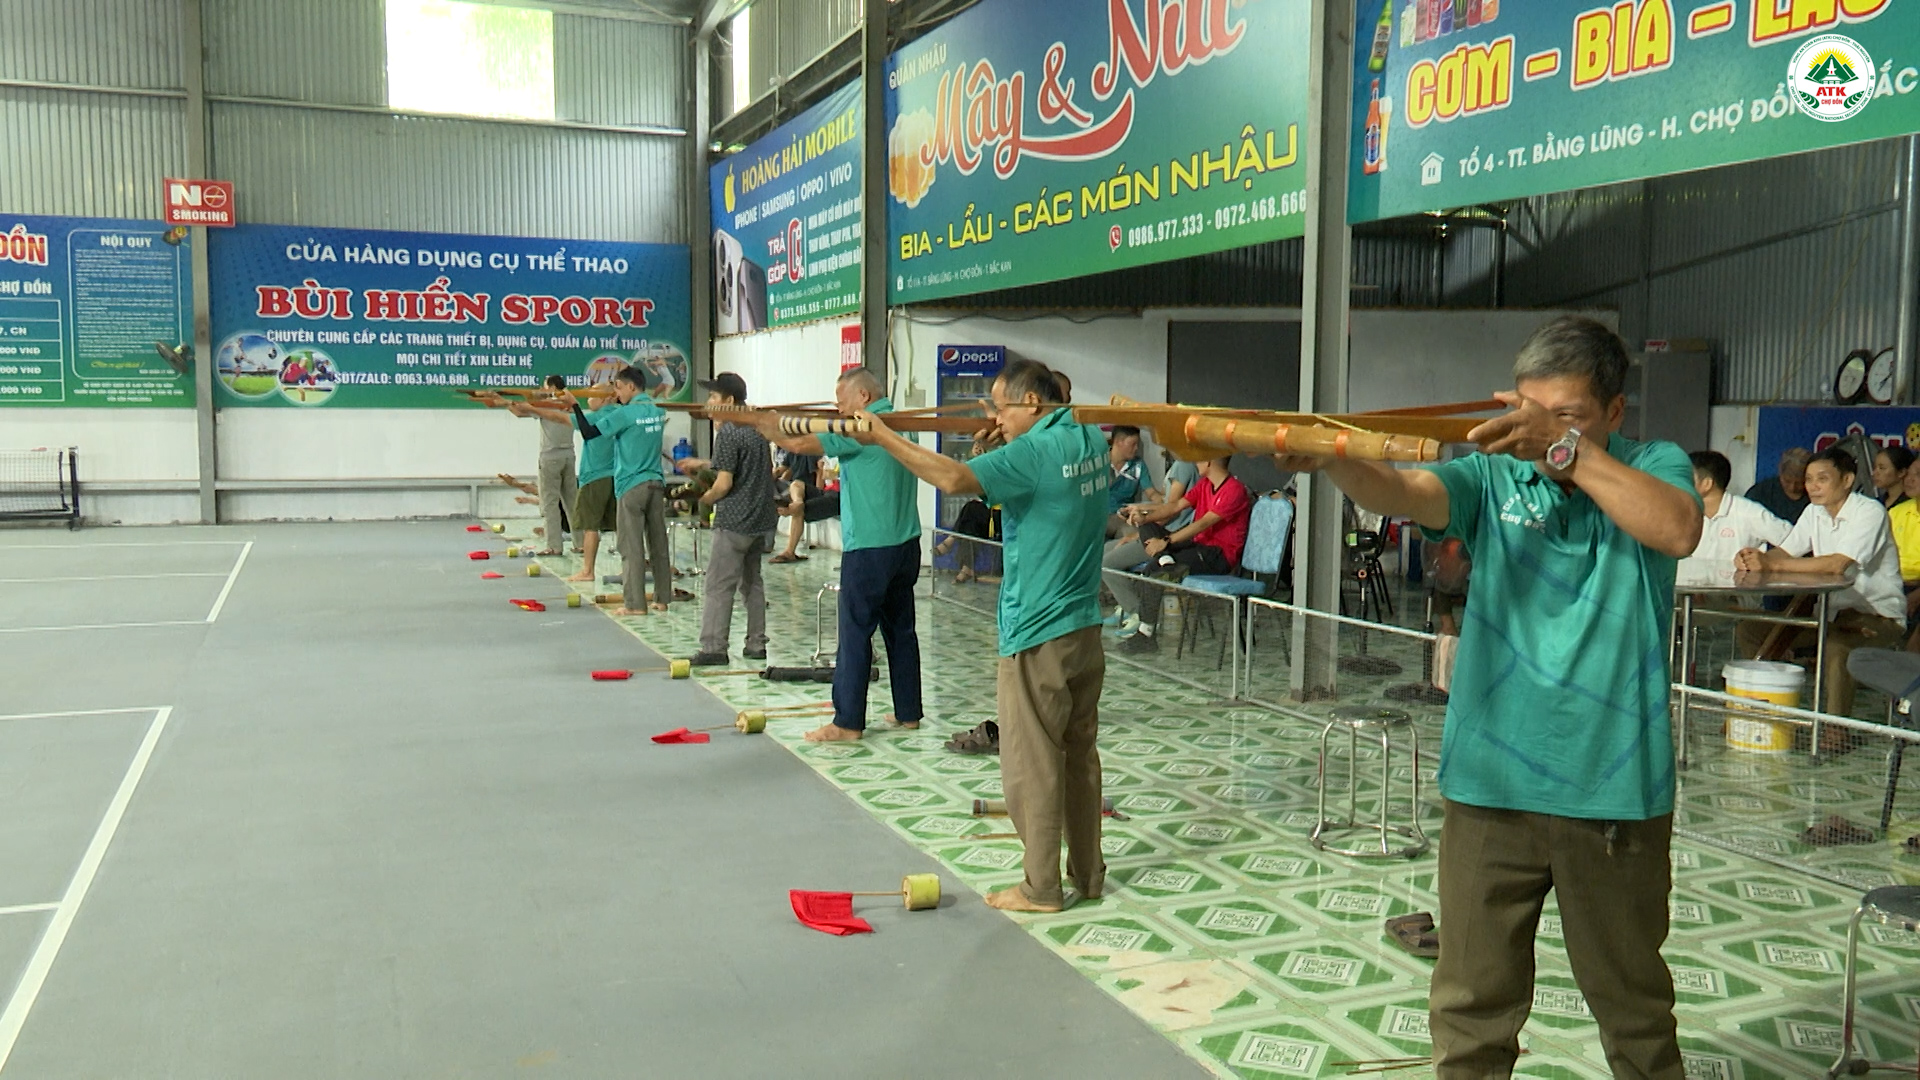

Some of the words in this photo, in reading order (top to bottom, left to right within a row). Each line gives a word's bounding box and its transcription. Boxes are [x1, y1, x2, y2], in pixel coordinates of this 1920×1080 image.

[889, 59, 916, 90] QUÁN
[918, 43, 947, 74] NHẬU
[1405, 33, 1516, 130] CƠM
[1570, 0, 1676, 92] BIA
[919, 57, 1025, 180] Mây
[1037, 41, 1093, 128] &
[1459, 145, 1480, 178] TỔ
[1483, 153, 1494, 172] 4
[1532, 132, 1586, 165] BẰNG
[1590, 123, 1644, 153] LŨNG
[1661, 115, 1683, 140] H.
[1690, 97, 1744, 134] CHỢ
[1872, 58, 1919, 99] ẮC
[741, 152, 780, 195] HOÀNG
[782, 133, 803, 174] HẢI
[805, 108, 856, 164] MOBILE
[735, 205, 758, 230] IPHONE
[762, 188, 796, 218] SAMSUNG
[800, 175, 824, 201] OPPO
[830, 161, 853, 188] VIVO
[900, 231, 933, 261] BIA
[948, 202, 994, 250] LẨU
[1013, 187, 1074, 235] CÁC
[1081, 163, 1160, 219] MÓN
[1170, 122, 1298, 196] NHẬU
[172, 209, 229, 222] SMOKING
[1128, 212, 1204, 248] 0986.977.333
[1215, 188, 1307, 230] 0972.468.666
[100, 233, 124, 249] NỘI
[127, 236, 152, 248] QUY
[285, 237, 338, 262] CỬA
[344, 243, 411, 265] HÀNG
[417, 250, 482, 272] DỤNG
[489, 253, 519, 274] CỤ
[526, 247, 566, 272] THỂ
[571, 256, 629, 274] THAO
[767, 230, 786, 255] TRẢ
[768, 259, 787, 284] GÓP
[256, 277, 353, 321] BÙI
[363, 275, 491, 325] HIỂN
[501, 293, 655, 328] SPORT
[266, 327, 314, 343] CHUYÊN
[317, 331, 350, 344] CUNG
[353, 328, 377, 344] CẤP
[380, 330, 403, 345] CÁC
[406, 333, 443, 346] TRANG
[447, 331, 477, 347] THIẾT
[497, 335, 527, 350] DỤNG
[551, 333, 580, 349] QUẦN
[582, 334, 597, 349] ÁO
[600, 333, 620, 350] THỂ
[621, 338, 648, 351] THAO
[396, 353, 419, 368] MỌI
[422, 354, 441, 366] CHI
[444, 350, 467, 367] TIẾT
[469, 355, 489, 367] XIN
[492, 353, 516, 367] LIÊN
[519, 354, 533, 370] HỆ
[961, 351, 998, 365] pepsi
[480, 374, 539, 386] FACEBOOK:
